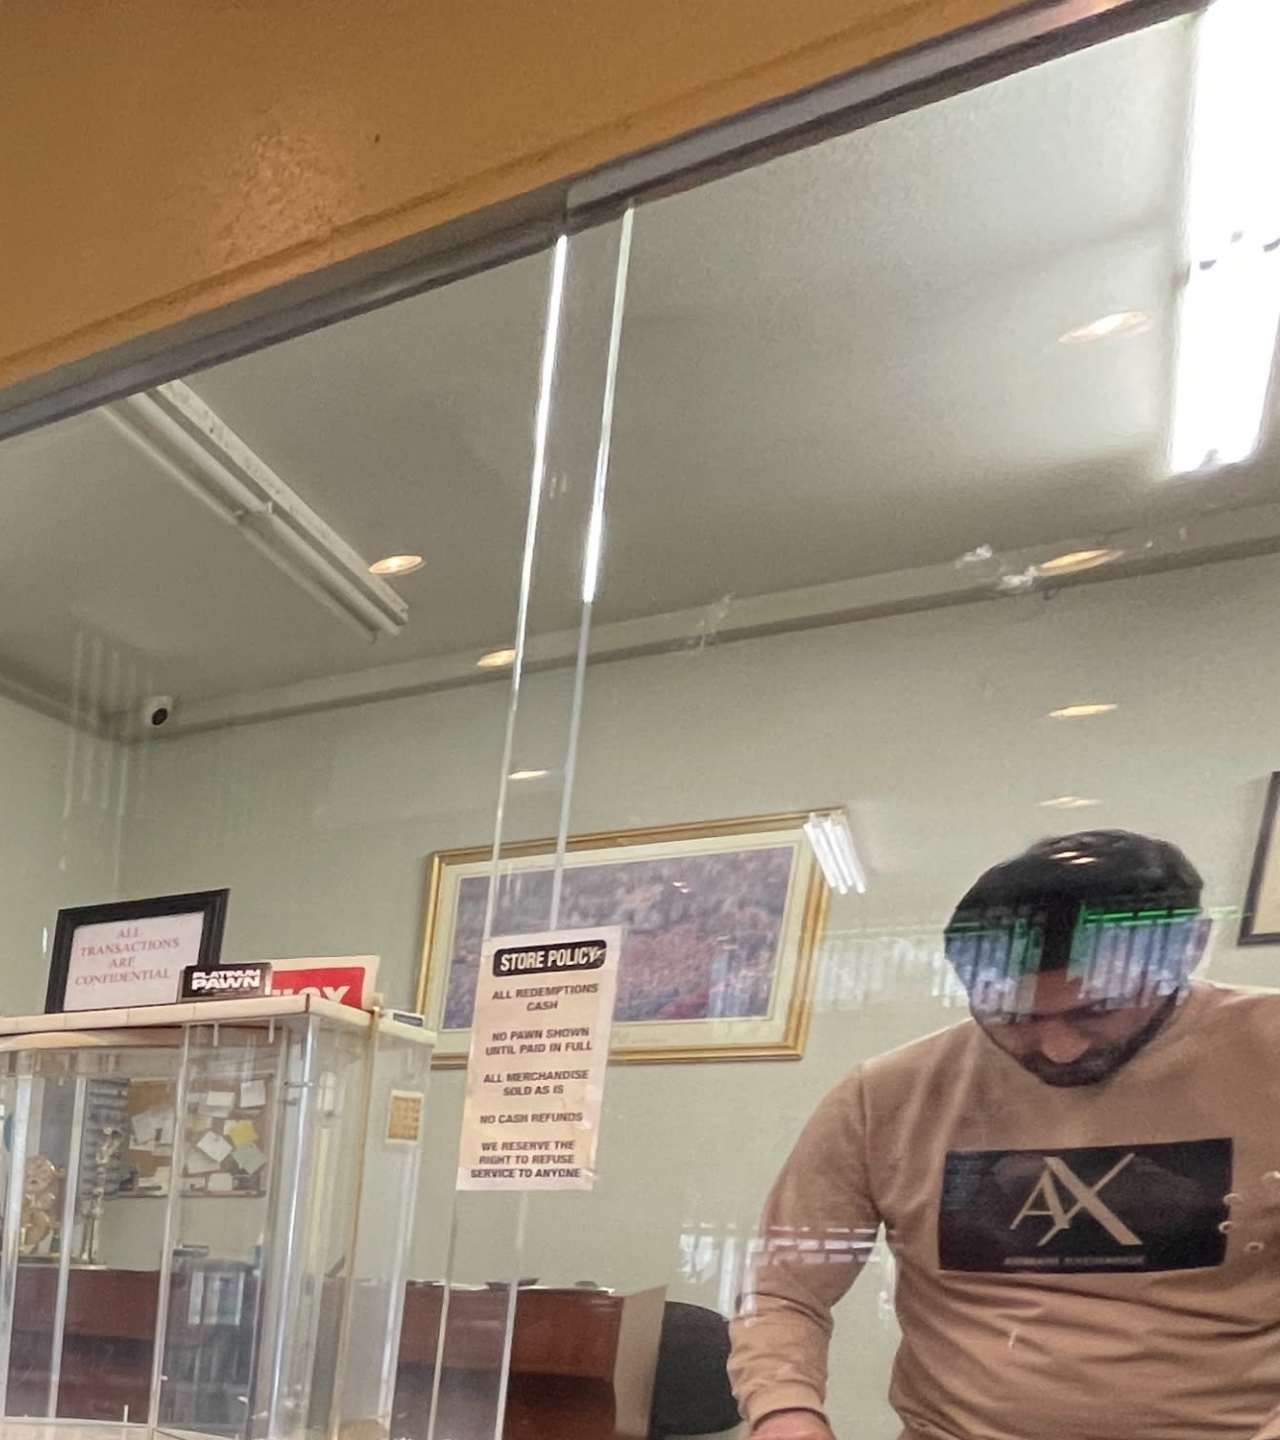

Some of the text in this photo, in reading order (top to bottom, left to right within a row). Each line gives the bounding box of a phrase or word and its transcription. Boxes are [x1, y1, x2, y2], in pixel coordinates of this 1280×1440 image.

[118, 927, 142, 938] ALL
[80, 937, 180, 957] TRANSACTIONS
[110, 956, 135, 968] ARE
[500, 945, 600, 972] STORE POLICY
[75, 968, 170, 986] CONFIDENTIAL
[192, 969, 261, 980] PLATINUM
[192, 975, 261, 991] PAWN
[492, 983, 600, 1000] ALL REDEMPTIONS
[526, 1000, 559, 1012] CASH
[492, 1027, 590, 1042] NO PAWN SHOWN
[485, 1041, 593, 1056] UNTIL PAID IN FULL
[483, 1069, 590, 1083] ALL MERCHANDISE
[503, 1085, 564, 1096] SOLD AS IS
[480, 1112, 584, 1124] NO CASH REFUNDS
[481, 1140, 575, 1151] WE RESERVE THE
[479, 1154, 575, 1165] RIGHT TO REFUSE
[471, 1168, 581, 1178] SERVICE TO ANYONE
[1009, 1152, 1143, 1247] AX
